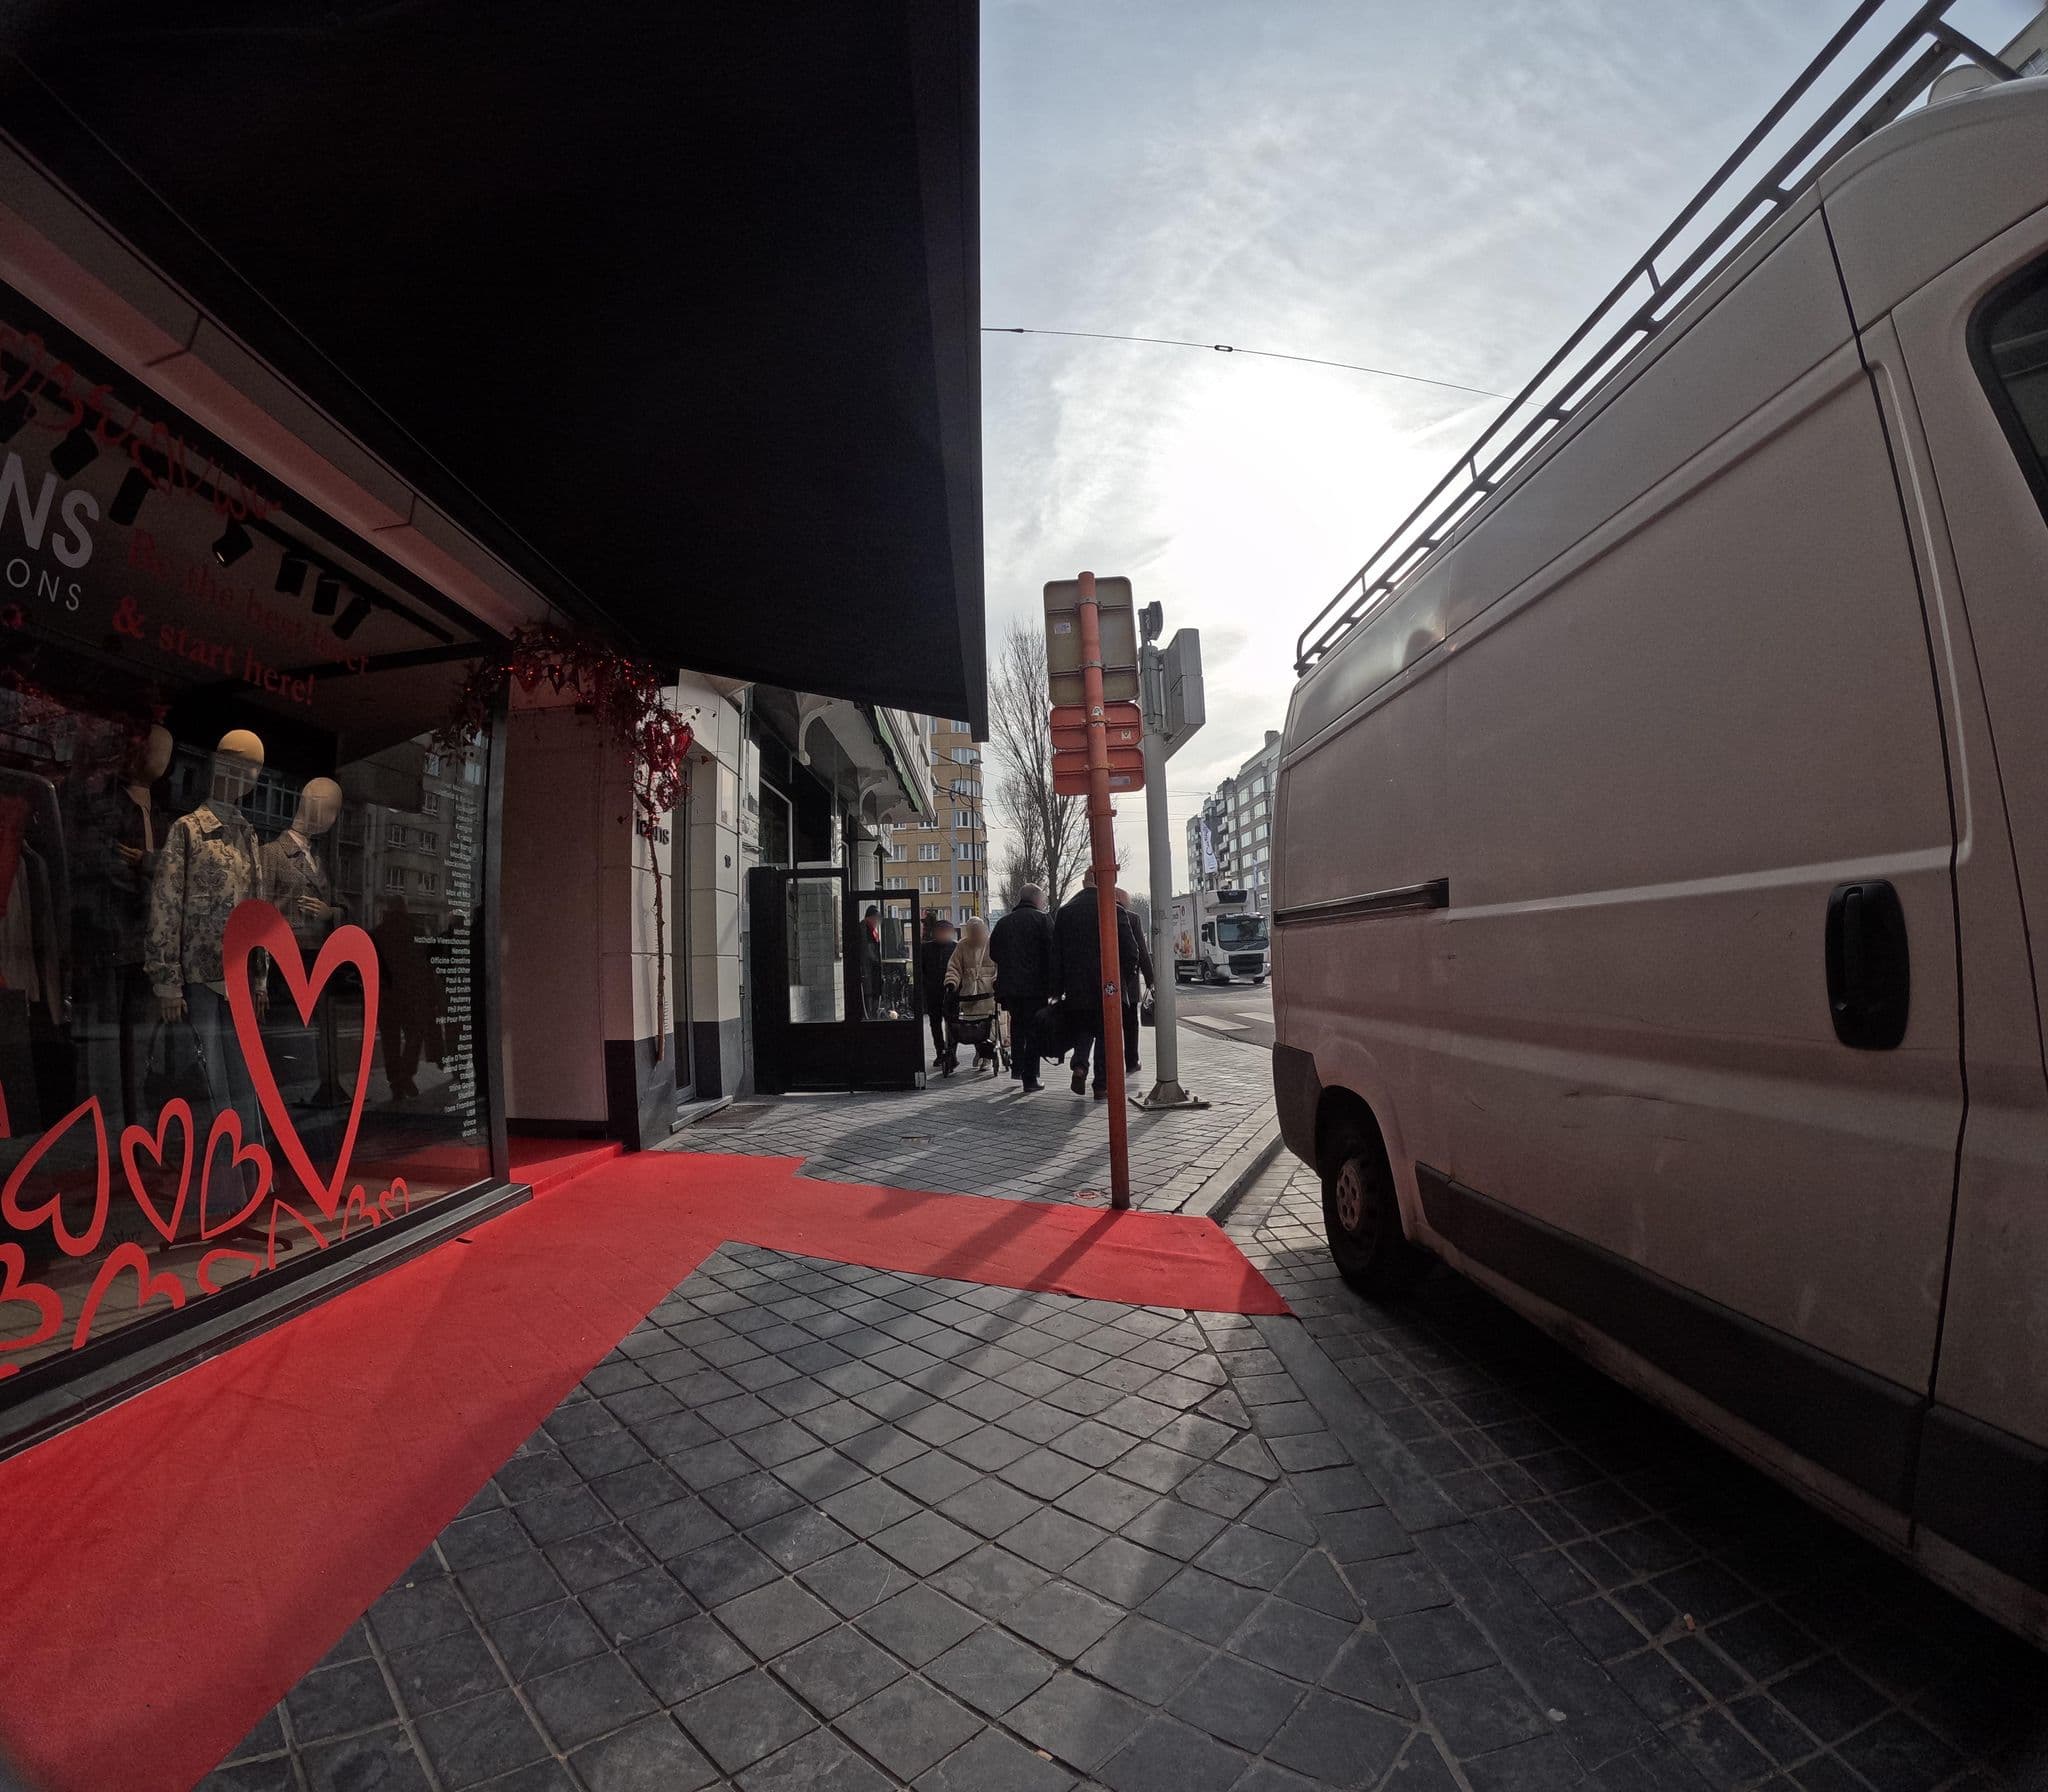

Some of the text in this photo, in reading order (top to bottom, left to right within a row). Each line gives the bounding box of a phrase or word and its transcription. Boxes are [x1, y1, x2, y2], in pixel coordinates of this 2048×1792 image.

[112, 594, 318, 704] & start here!
[635, 811, 669, 845] icns
[446, 985, 470, 994] Paul Smith
